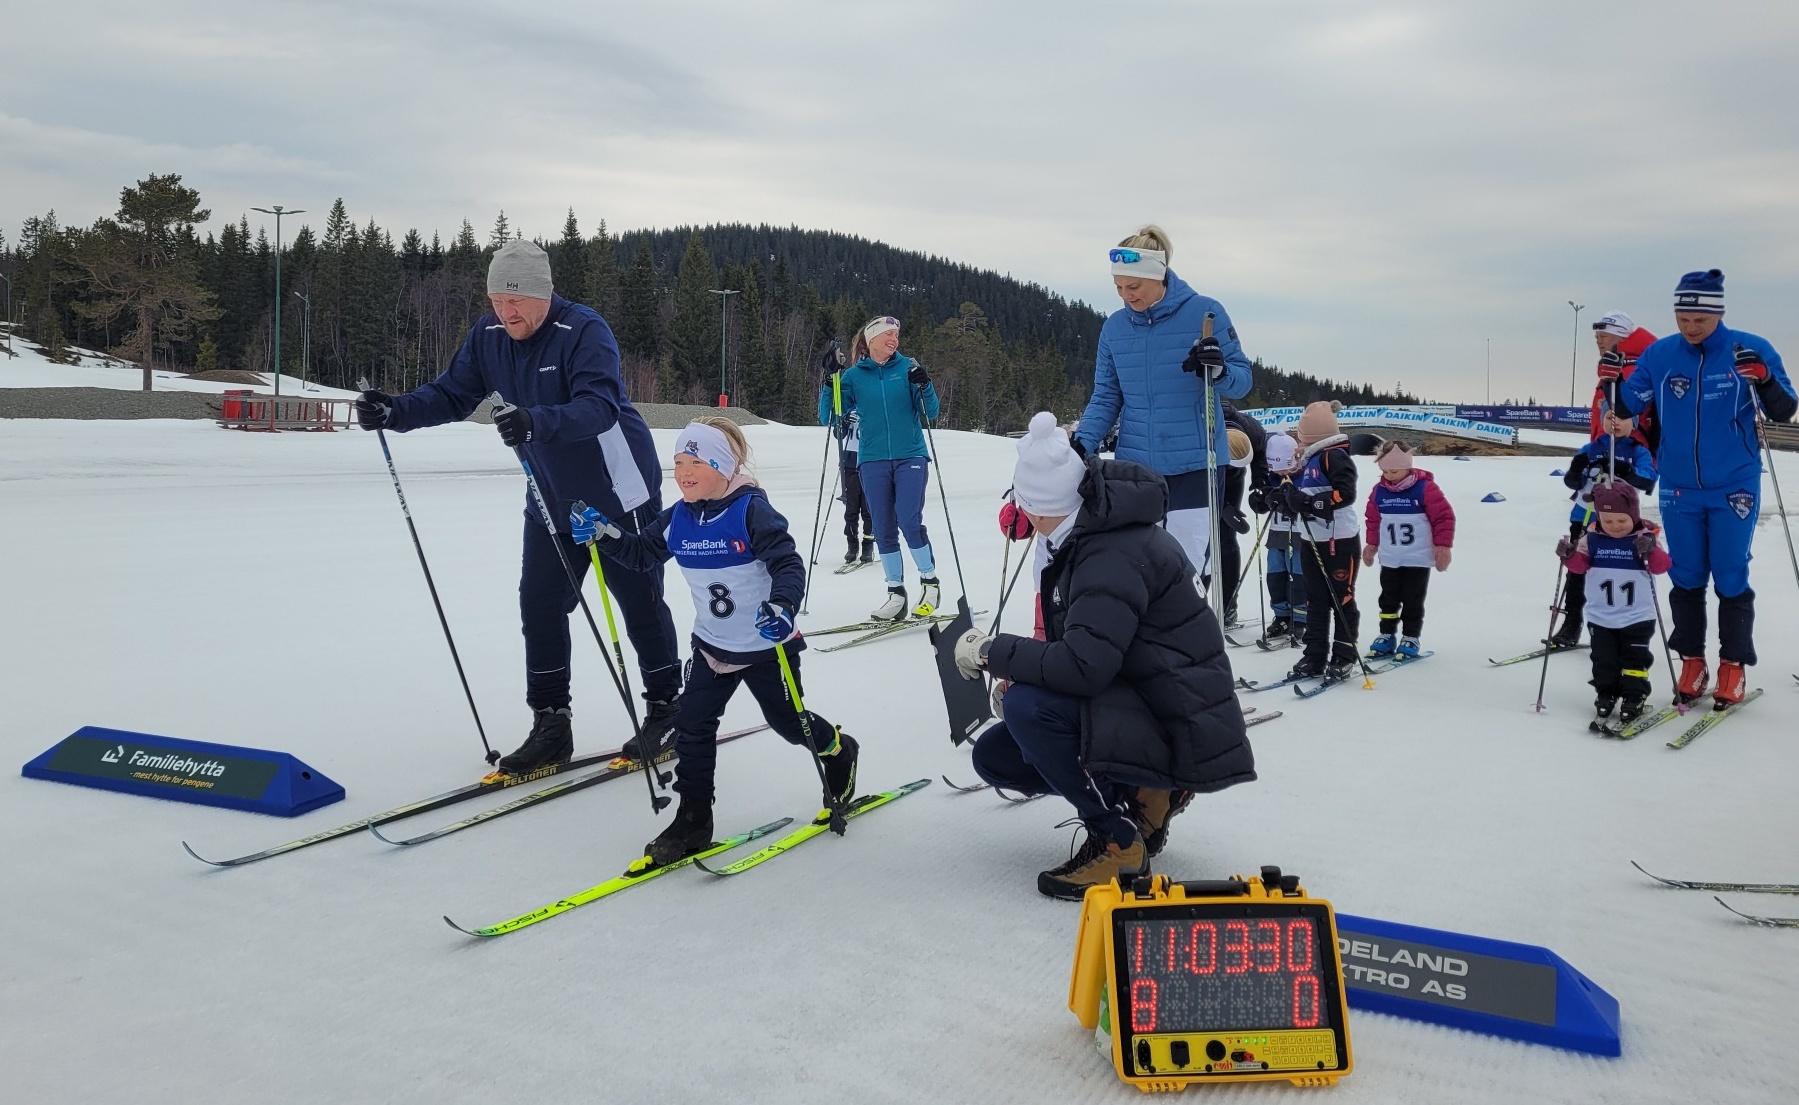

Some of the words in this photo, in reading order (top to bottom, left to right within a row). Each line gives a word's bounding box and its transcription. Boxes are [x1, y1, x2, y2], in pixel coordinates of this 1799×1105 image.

[1385, 412, 1424, 421] DAIKIN
[1432, 416, 1468, 428] DAIKIN
[1506, 409, 1540, 417] SpareBank
[1476, 424, 1513, 435] DAIKIN
[1387, 523, 1415, 546] 13
[681, 539, 727, 550] SpareBank
[1597, 548, 1633, 556] SpareBank
[706, 582, 736, 619] 8
[1599, 579, 1636, 607] 11
[128, 750, 226, 777] Familiehytta
[133, 771, 151, 779] mest
[152, 774, 172, 783] hytte
[171, 776, 183, 784] for
[181, 779, 215, 789] pengene
[1421, 980, 1467, 1001] AS
[1131, 978, 1158, 1033] 8
[1292, 974, 1319, 1027] 0
